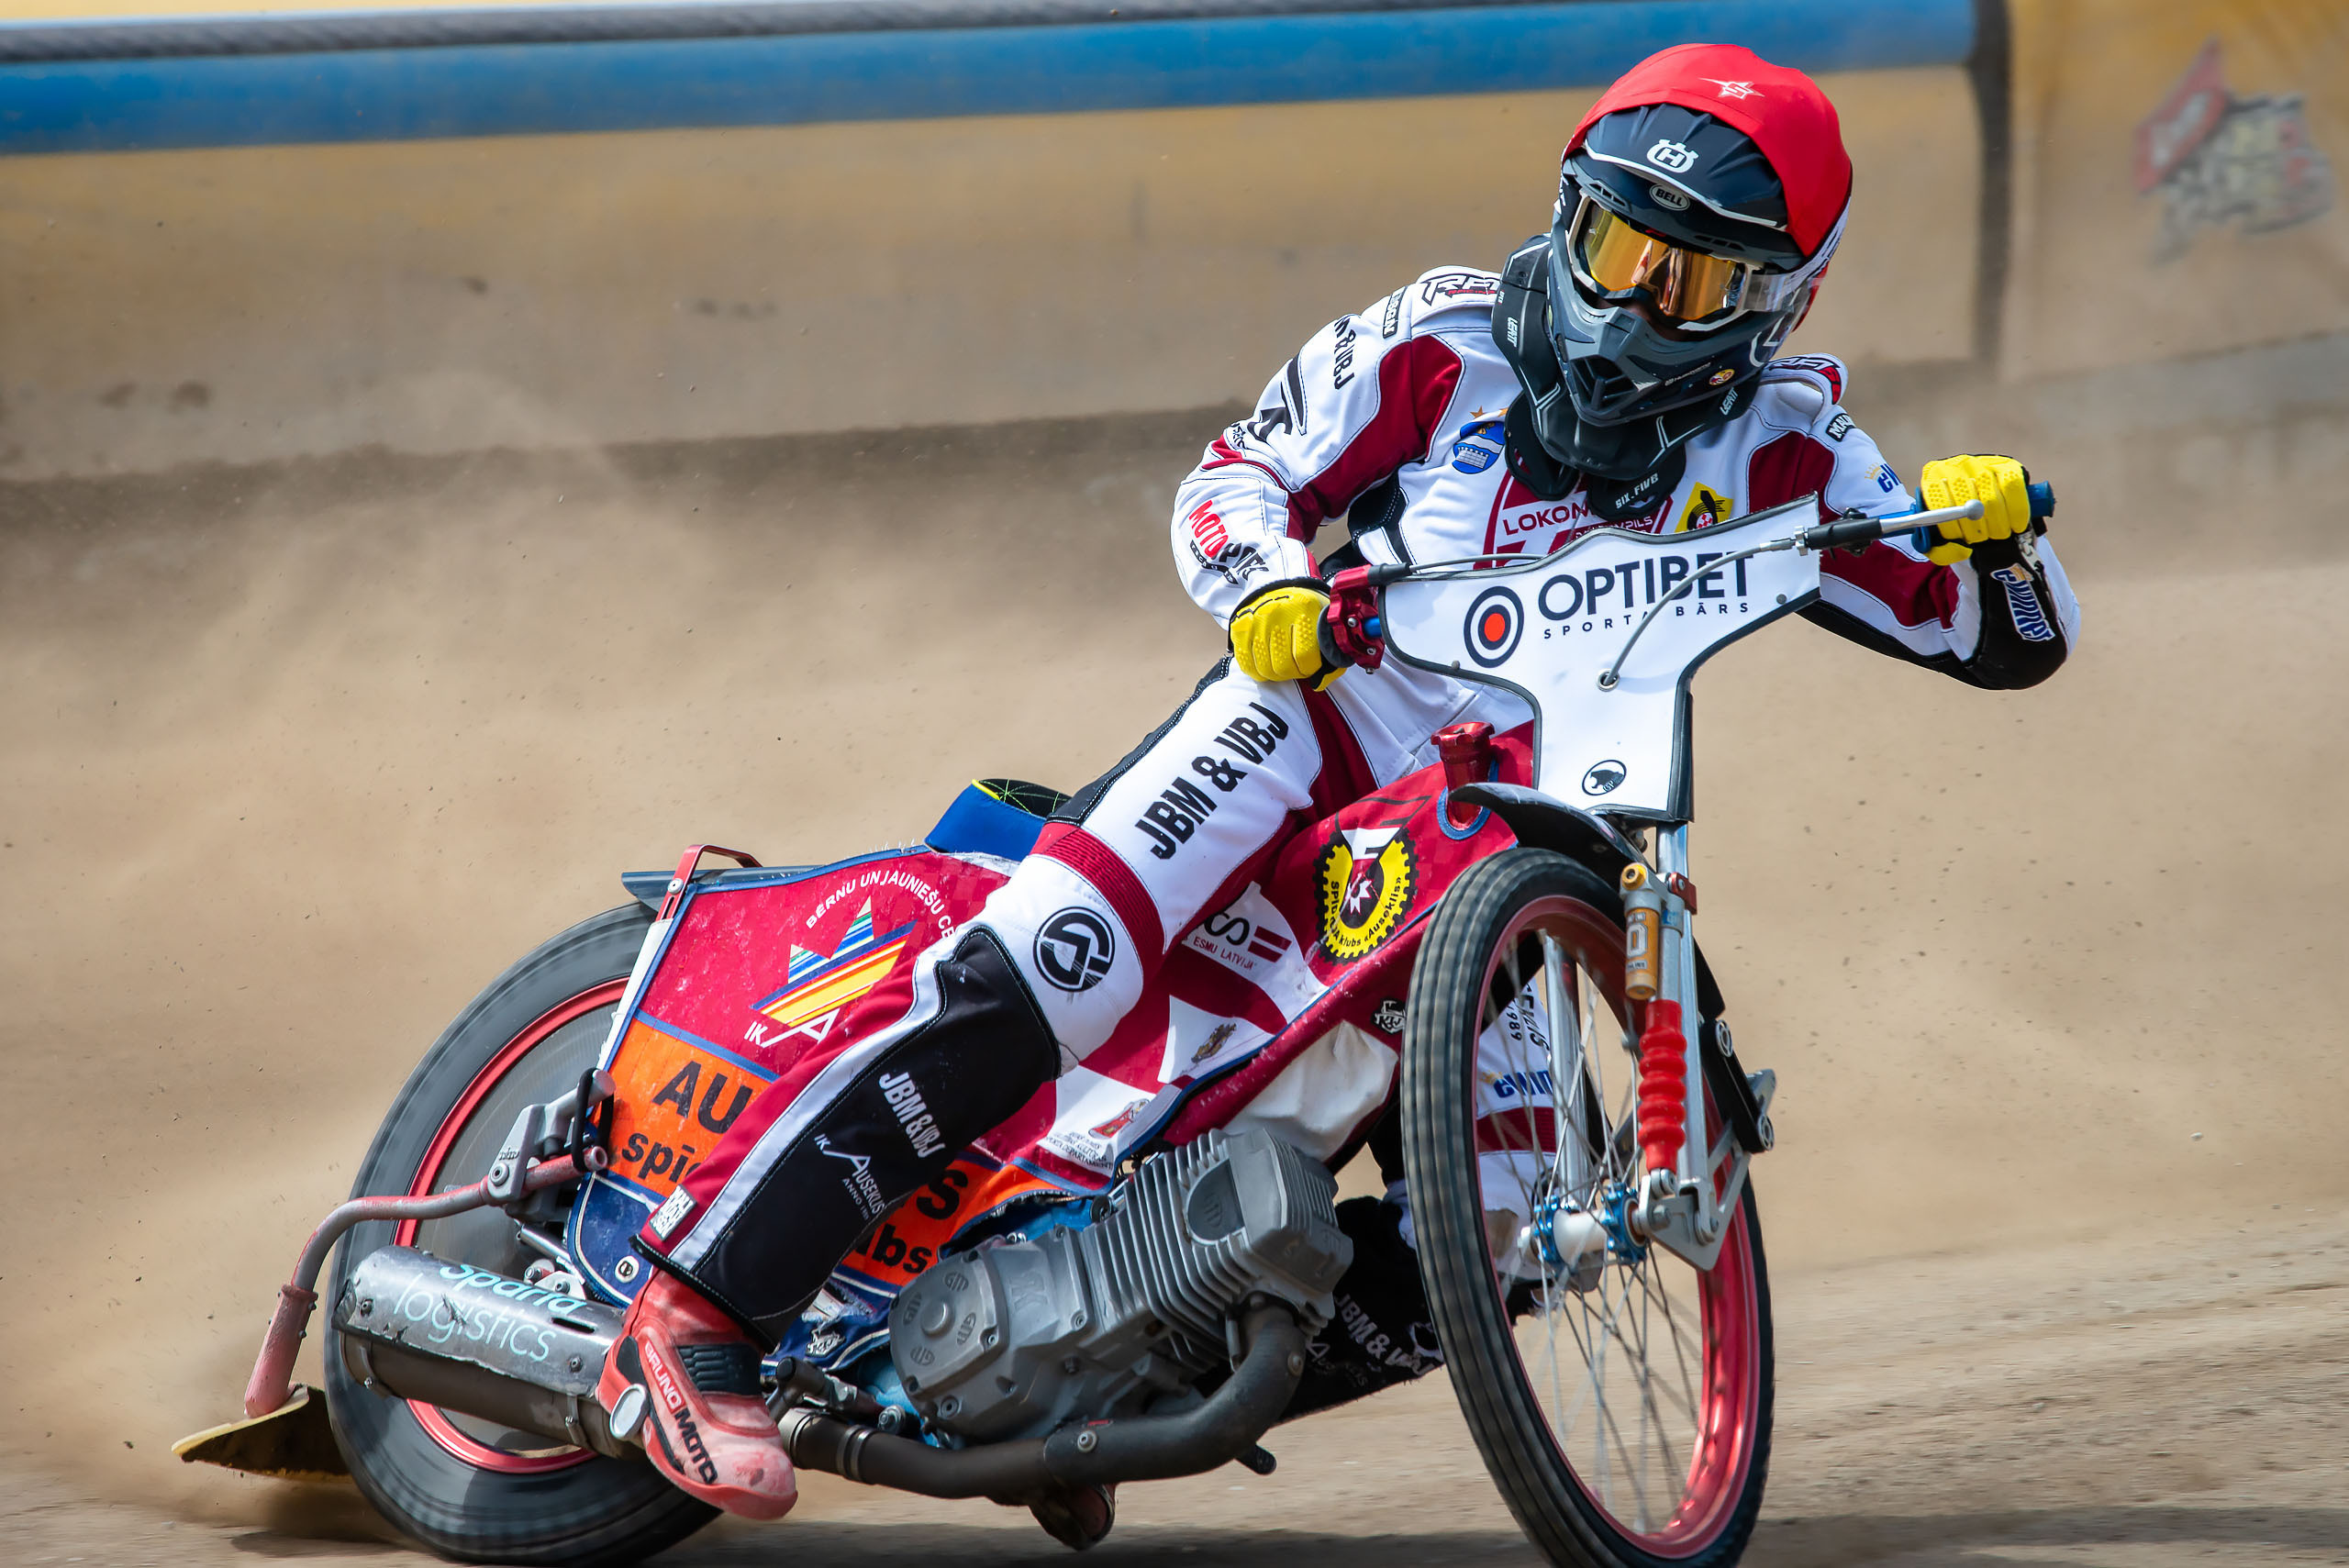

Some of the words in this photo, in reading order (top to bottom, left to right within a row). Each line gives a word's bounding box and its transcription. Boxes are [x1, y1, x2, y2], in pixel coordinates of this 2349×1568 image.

[1654, 187, 1684, 206] BELL
[1538, 550, 1754, 621] OPTIBET
[1675, 602, 1748, 617] BĀRS
[1213, 701, 1289, 765] VBJ
[1191, 755, 1248, 792] &
[1134, 776, 1218, 860] JBM
[806, 878, 856, 929] BĒRNU
[859, 870, 881, 888] UN
[879, 870, 945, 916] JAUNIEŠU
[1193, 935, 1219, 955] ESMU
[1338, 935, 1362, 948] klubs
[743, 1020, 769, 1047] IK
[841, 1178, 863, 1205] ANNO
[393, 1273, 557, 1362] logistics
[644, 1340, 682, 1410] BRUNO
[674, 1407, 718, 1485] MOTO
